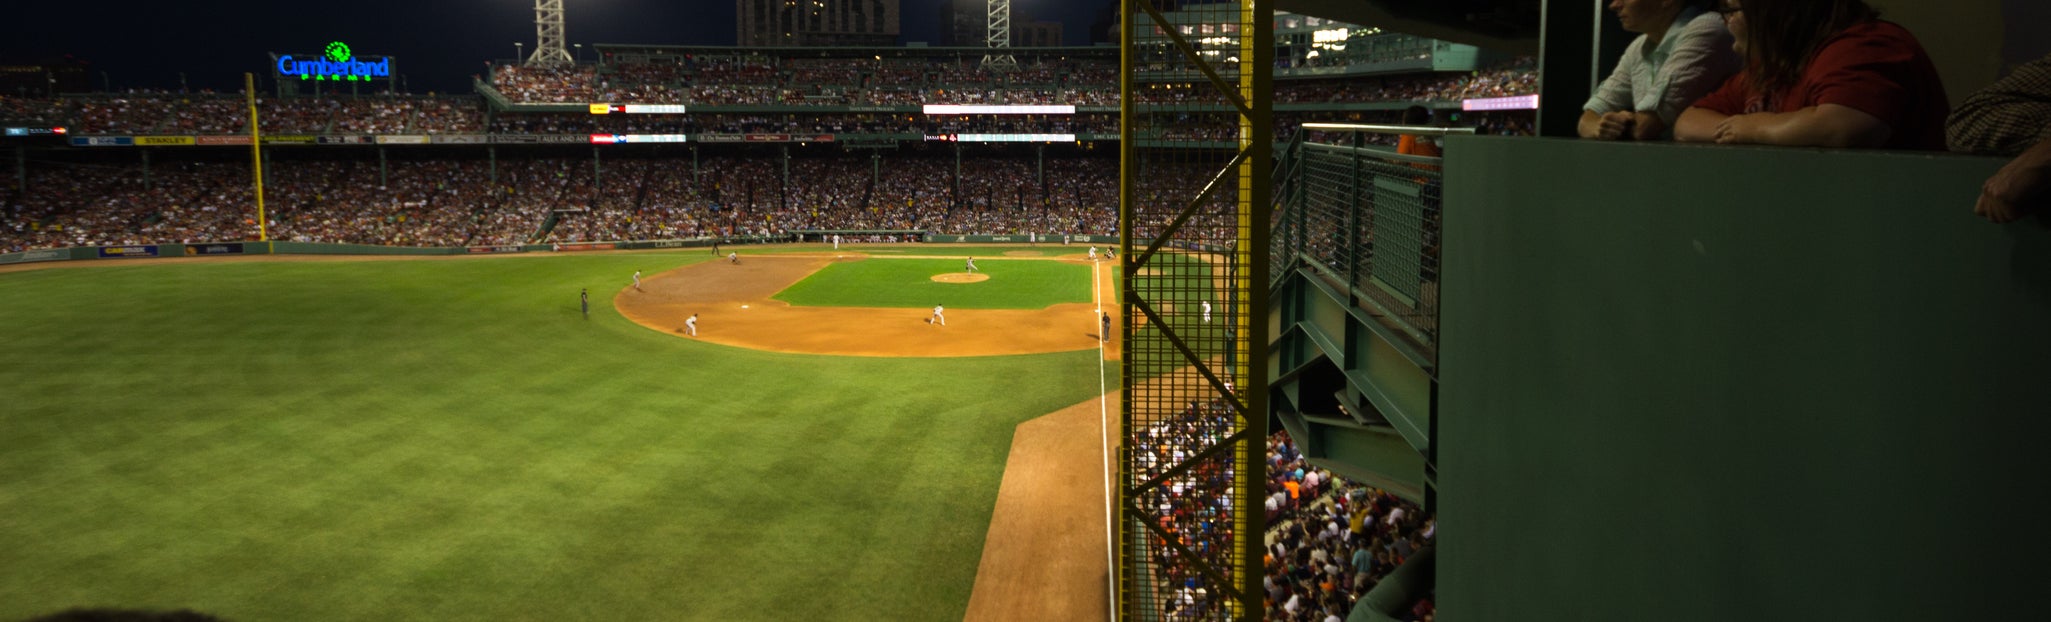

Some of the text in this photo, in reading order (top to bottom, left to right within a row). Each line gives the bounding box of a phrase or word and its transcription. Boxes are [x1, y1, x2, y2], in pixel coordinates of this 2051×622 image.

[277, 54, 390, 77] Cumberland
[301, 74, 371, 82] FARMS
[145, 136, 187, 144] STANLEY
